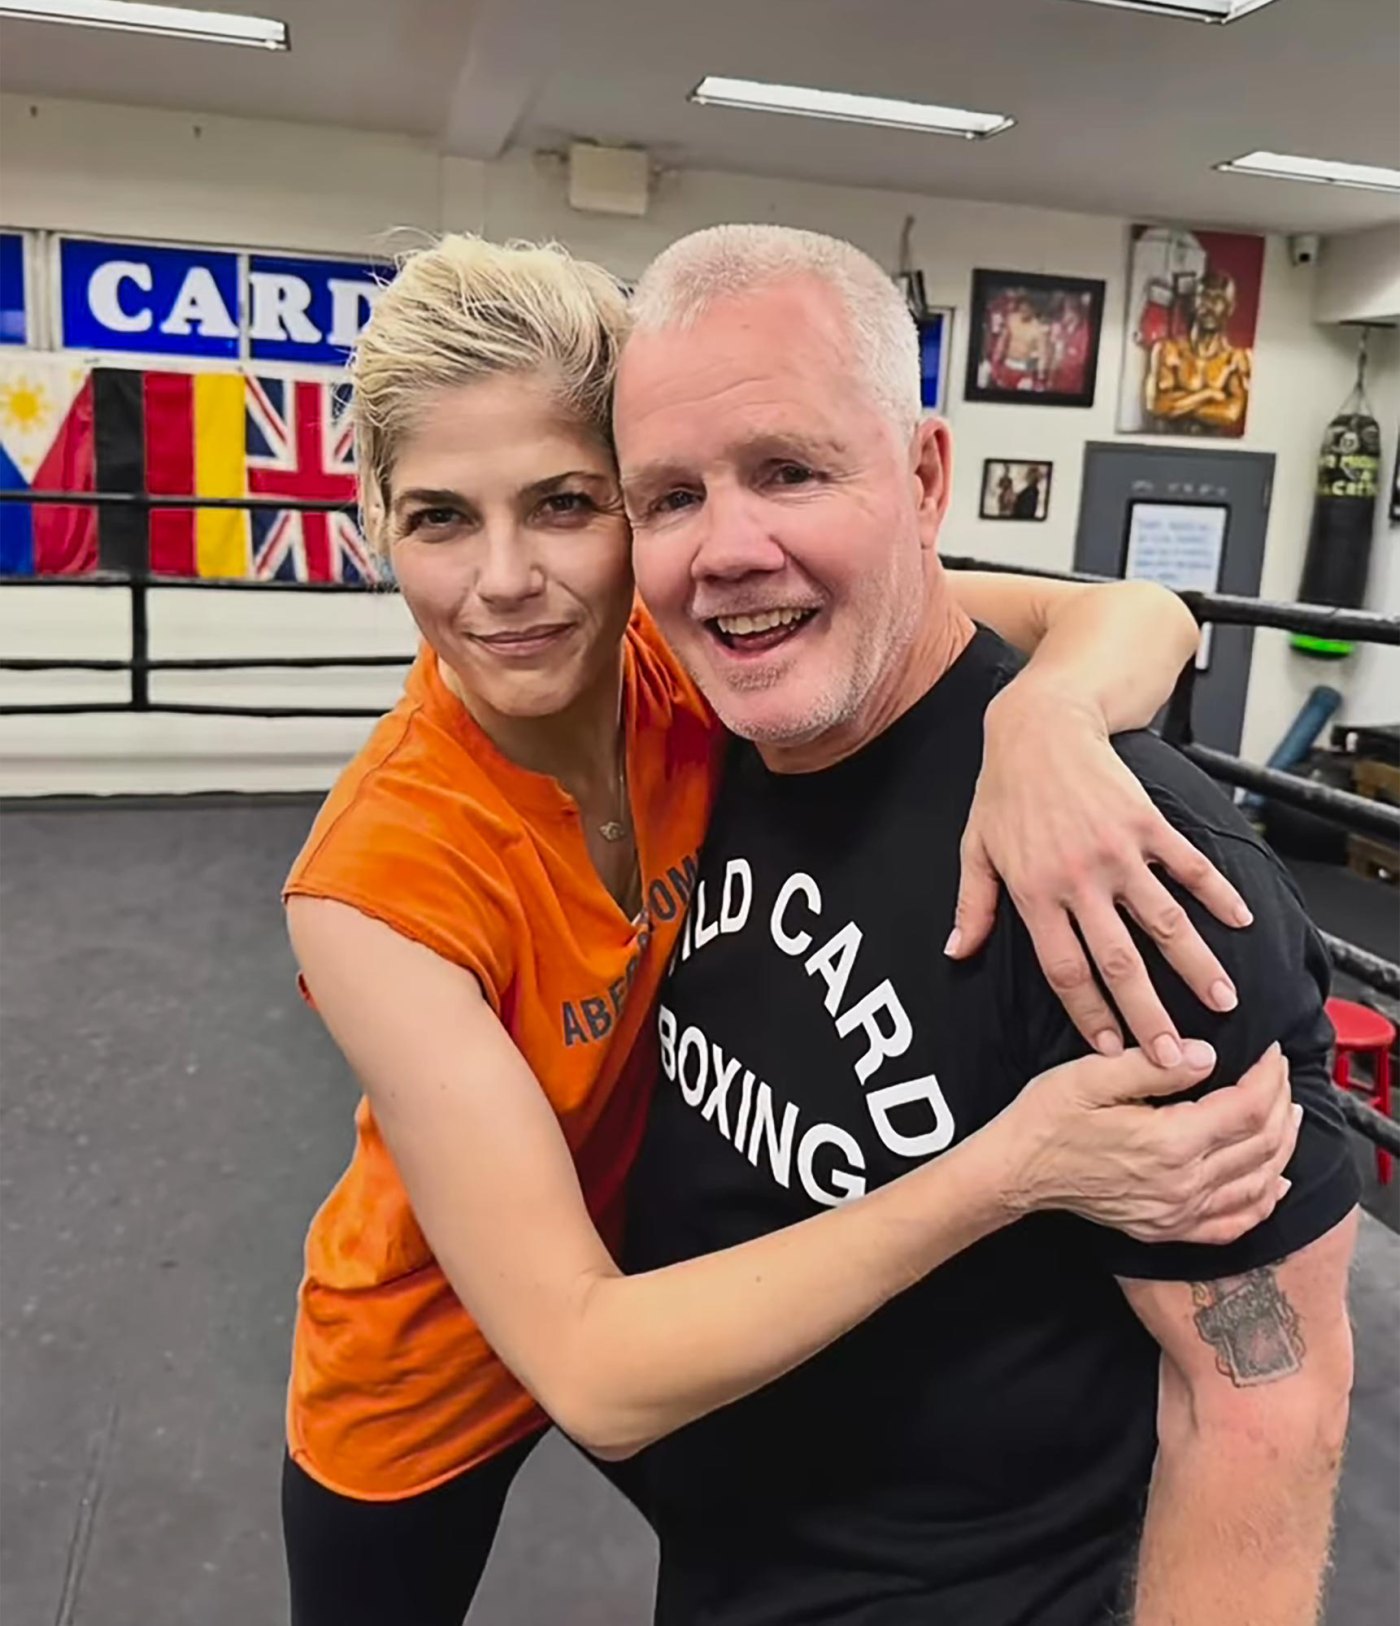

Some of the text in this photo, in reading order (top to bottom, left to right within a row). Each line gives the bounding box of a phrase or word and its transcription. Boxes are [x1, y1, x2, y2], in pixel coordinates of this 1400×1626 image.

[87, 260, 378, 345] CARD
[658, 1004, 867, 1208] BOXING
[670, 857, 956, 1158] ILD CARD
